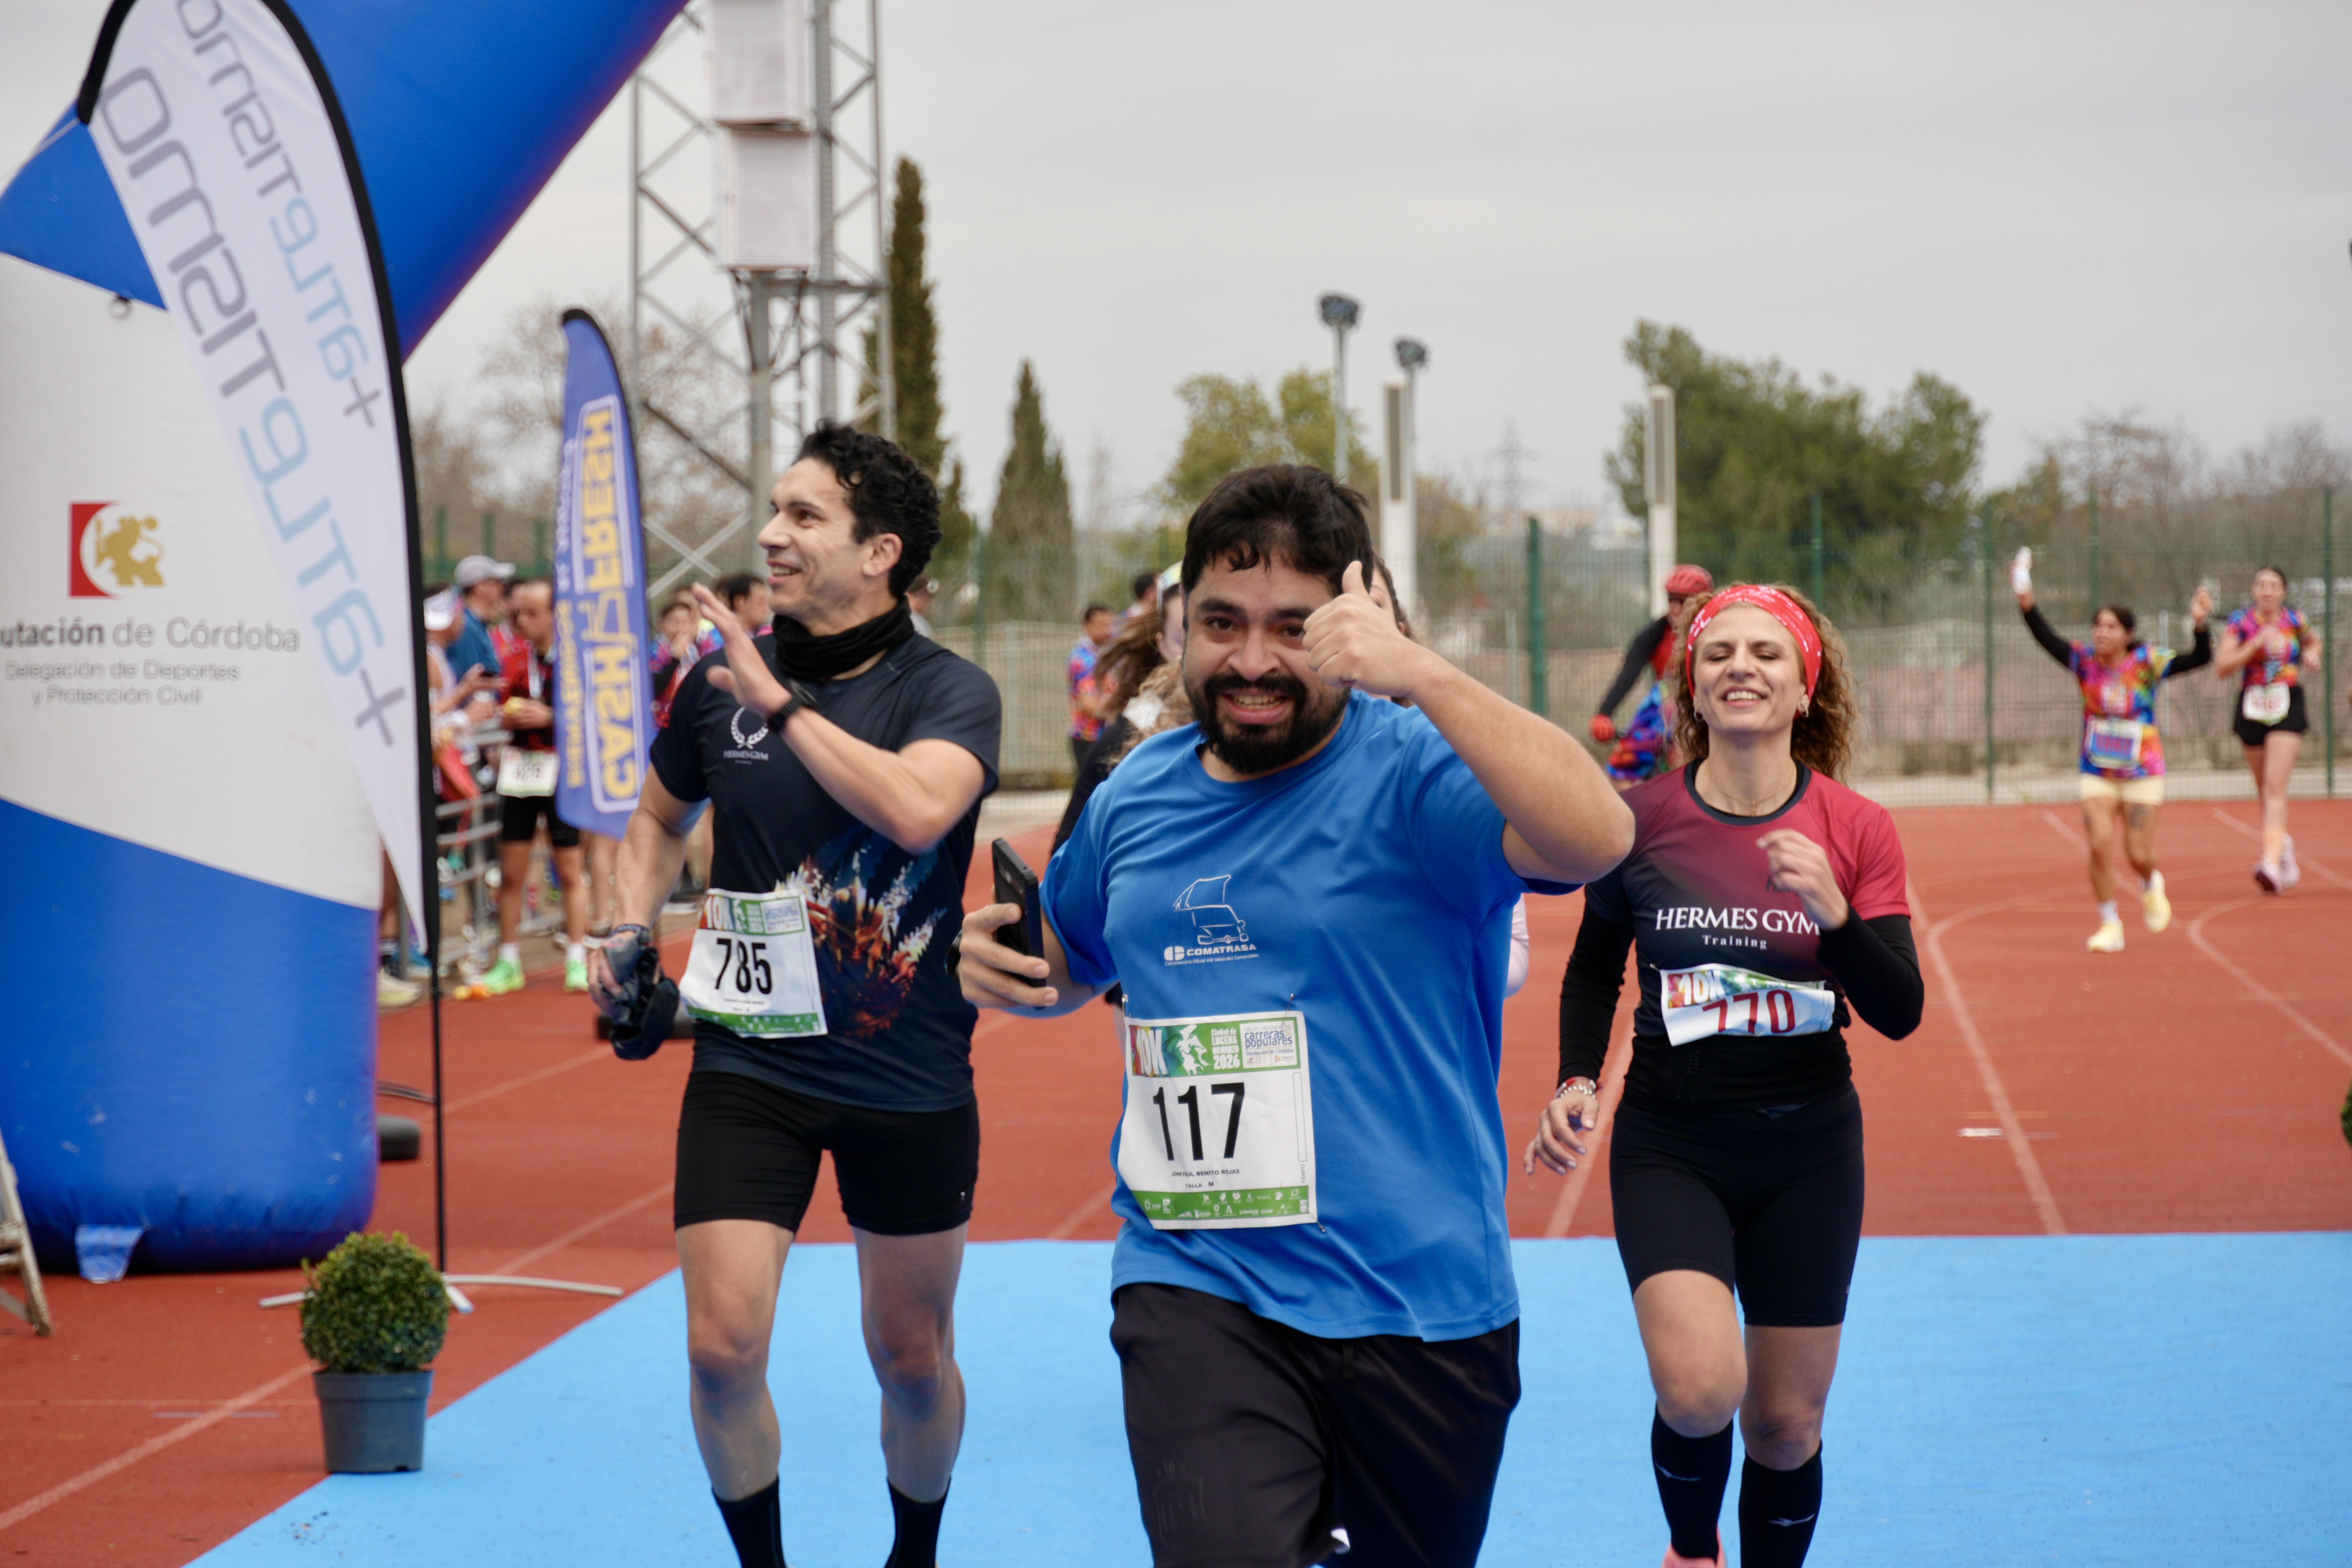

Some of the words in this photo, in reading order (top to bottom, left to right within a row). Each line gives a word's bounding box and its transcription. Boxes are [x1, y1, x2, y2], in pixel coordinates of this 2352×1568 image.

[113, 617, 154, 647] de
[166, 616, 301, 652] Córdoba
[5, 660, 104, 683] Delegación
[110, 659, 138, 681] de
[144, 659, 241, 683] Deportes
[32, 689, 44, 707] y
[46, 685, 150, 705] Protección
[156, 686, 202, 706] Civil
[1655, 906, 1758, 931] HERMES
[1762, 908, 1821, 936] GYM
[1187, 944, 1257, 956] COMATRASA
[1702, 934, 1767, 950] Training
[714, 938, 772, 994] 785
[1679, 970, 1726, 1006] 10K
[1702, 989, 1796, 1034] 770
[1211, 1035, 1238, 1046] LUCENA
[1245, 1030, 1284, 1040] carreras
[1246, 1036, 1293, 1050] populares
[1213, 1054, 1240, 1070] 2026
[1152, 1082, 1245, 1161] 117
